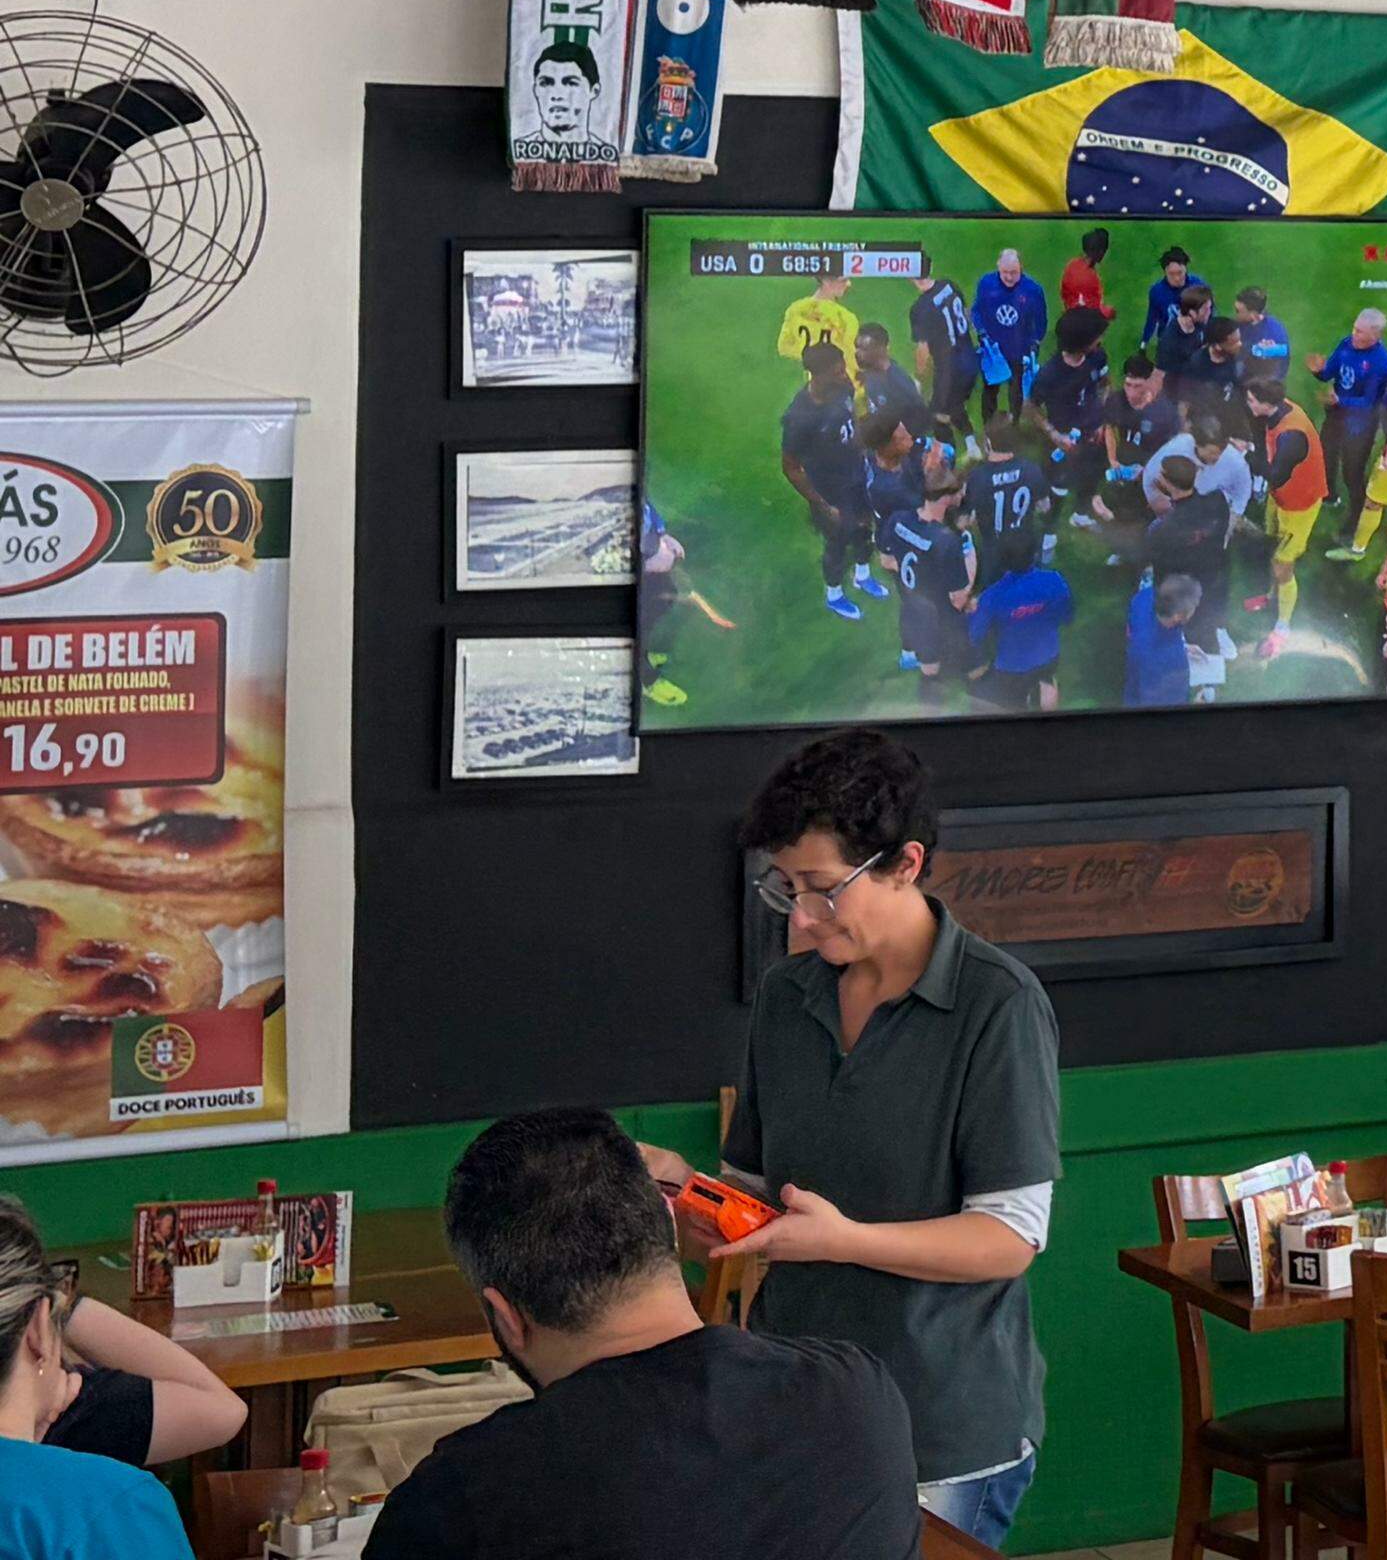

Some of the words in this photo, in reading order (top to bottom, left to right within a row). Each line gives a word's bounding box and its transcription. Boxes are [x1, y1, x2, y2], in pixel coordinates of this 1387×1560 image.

[514, 141, 617, 161] RONALDO
[1086, 132, 1145, 152] ORDEM
[1154, 143, 1163, 153] E
[1173, 146, 1279, 193] PROGRESSO
[747, 242, 821, 252] INTERNATIONAL
[701, 255, 737, 272] USA
[750, 253, 764, 274] 0
[782, 256, 831, 272] 68:51
[851, 254, 863, 274] 2
[877, 256, 911, 272] POR
[172, 489, 241, 537] 50
[28, 634, 73, 670] DE
[82, 624, 196, 668] BELÉM
[49, 675, 65, 692] DE
[68, 672, 103, 692] NATA
[43, 699, 52, 716] E
[54, 696, 117, 716] SORVETE
[119, 694, 136, 712] DE
[139, 693, 186, 711] CREME
[3, 723, 126, 777] 16,90
[118, 1099, 161, 1116] DOCE
[164, 1088, 256, 1113] PORTUGUÊS
[1293, 1256, 1317, 1282] 15
